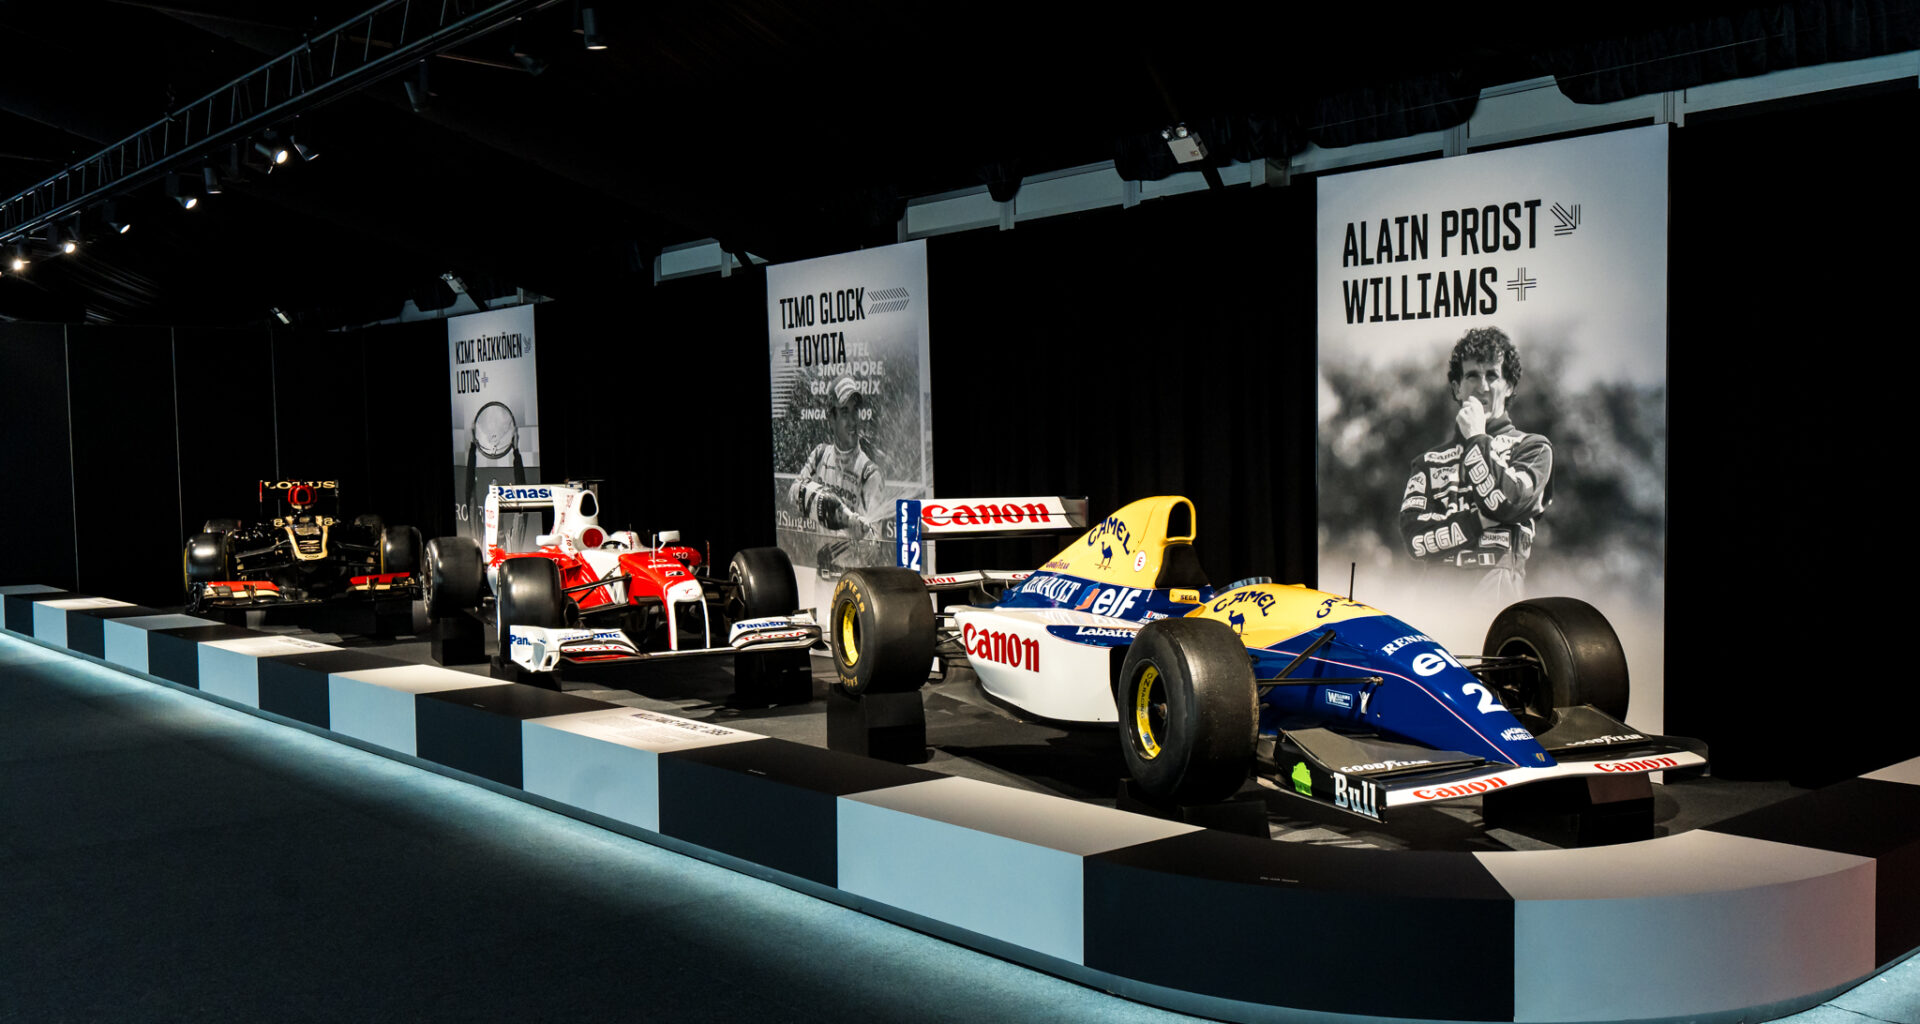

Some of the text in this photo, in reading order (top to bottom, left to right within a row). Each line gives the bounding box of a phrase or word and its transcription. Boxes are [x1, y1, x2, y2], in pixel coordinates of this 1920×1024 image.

[1342, 199, 1542, 268] ALAIN PROST
[779, 287, 866, 330] TIMO GLOCK
[1342, 266, 1498, 324] WILLIAMS
[455, 332, 523, 365] KIMI RÄIKKÖNEN
[795, 332, 846, 367] TOYOTA
[456, 369, 480, 394] LOTUS
[818, 361, 883, 376] SINGAPORE
[800, 408, 827, 420] SINGA
[1464, 444, 1506, 512] SEGA
[498, 486, 553, 500] Panas
[921, 503, 1051, 526] Canon
[901, 502, 909, 567] SEG
[1087, 517, 1130, 555] CAMEL
[1412, 522, 1468, 557] SEGA
[910, 541, 921, 572] 2
[1137, 556, 1143, 567] E
[1021, 576, 1082, 603] RENAULT
[1091, 587, 1142, 618] elf
[1180, 594, 1198, 602] SEGA
[1213, 591, 1276, 617] CAMEL
[737, 621, 786, 630] Panaso
[740, 631, 808, 642] TOYOTA
[562, 645, 625, 653] OYOTA
[963, 622, 1040, 673] Canon
[1412, 648, 1467, 677] el
[1462, 682, 1509, 715] 2
[1566, 733, 1644, 747] GOODYEAR
[1340, 760, 1432, 773] GOODYEAR
[1594, 757, 1678, 773] Canon
[1333, 772, 1380, 819] Bull
[1412, 777, 1508, 800] Canon
